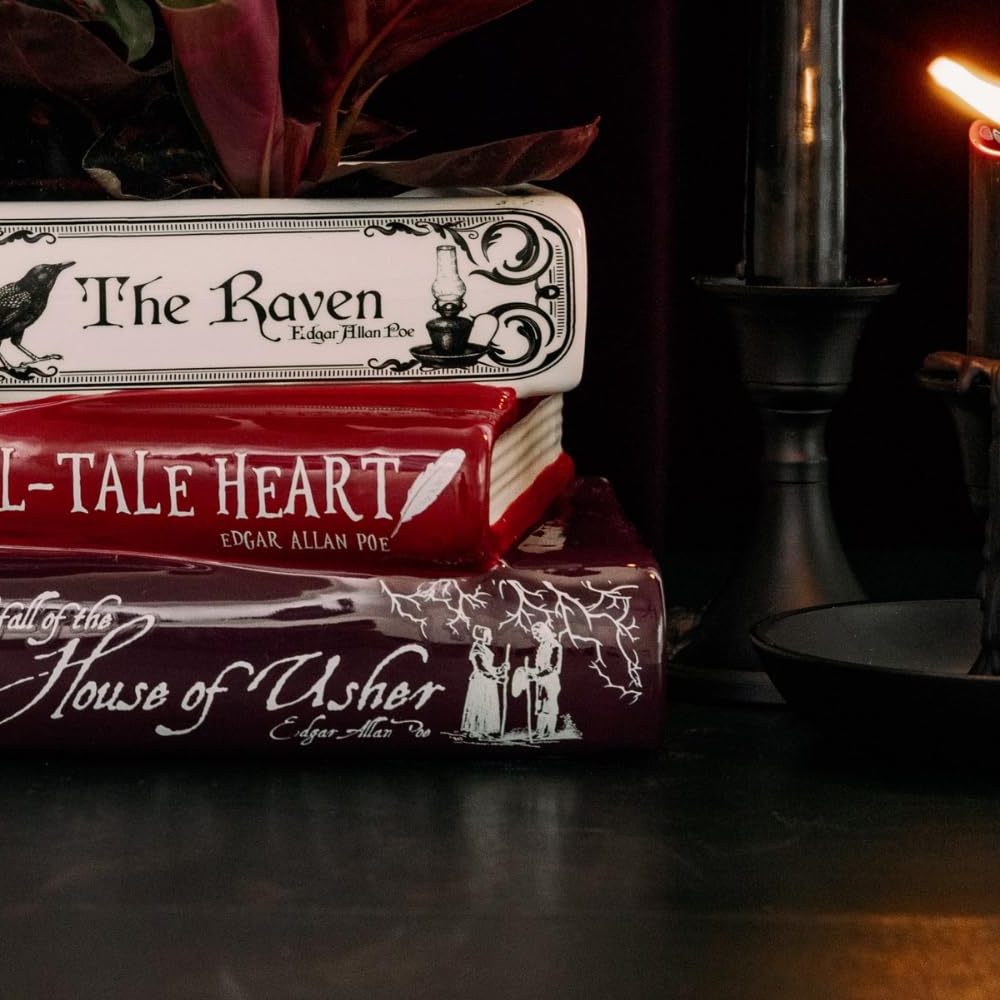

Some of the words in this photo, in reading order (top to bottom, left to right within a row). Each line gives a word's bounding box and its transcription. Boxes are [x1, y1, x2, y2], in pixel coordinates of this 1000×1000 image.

[74, 275, 191, 329] The
[209, 269, 384, 343] Raven
[288, 324, 339, 345] Edgar
[336, 323, 382, 345] Allan
[384, 322, 415, 339] Poe
[214, 451, 400, 522] HEART
[220, 530, 282, 551] EDGAR
[291, 530, 348, 550] ALLAN
[356, 532, 391, 552] POE
[26, 602, 80, 646] of
[72, 594, 122, 630] the
[154, 660, 255, 736] of
[247, 643, 446, 712] Usher
[269, 714, 338, 746] Edgar
[335, 716, 394, 740] Allan
